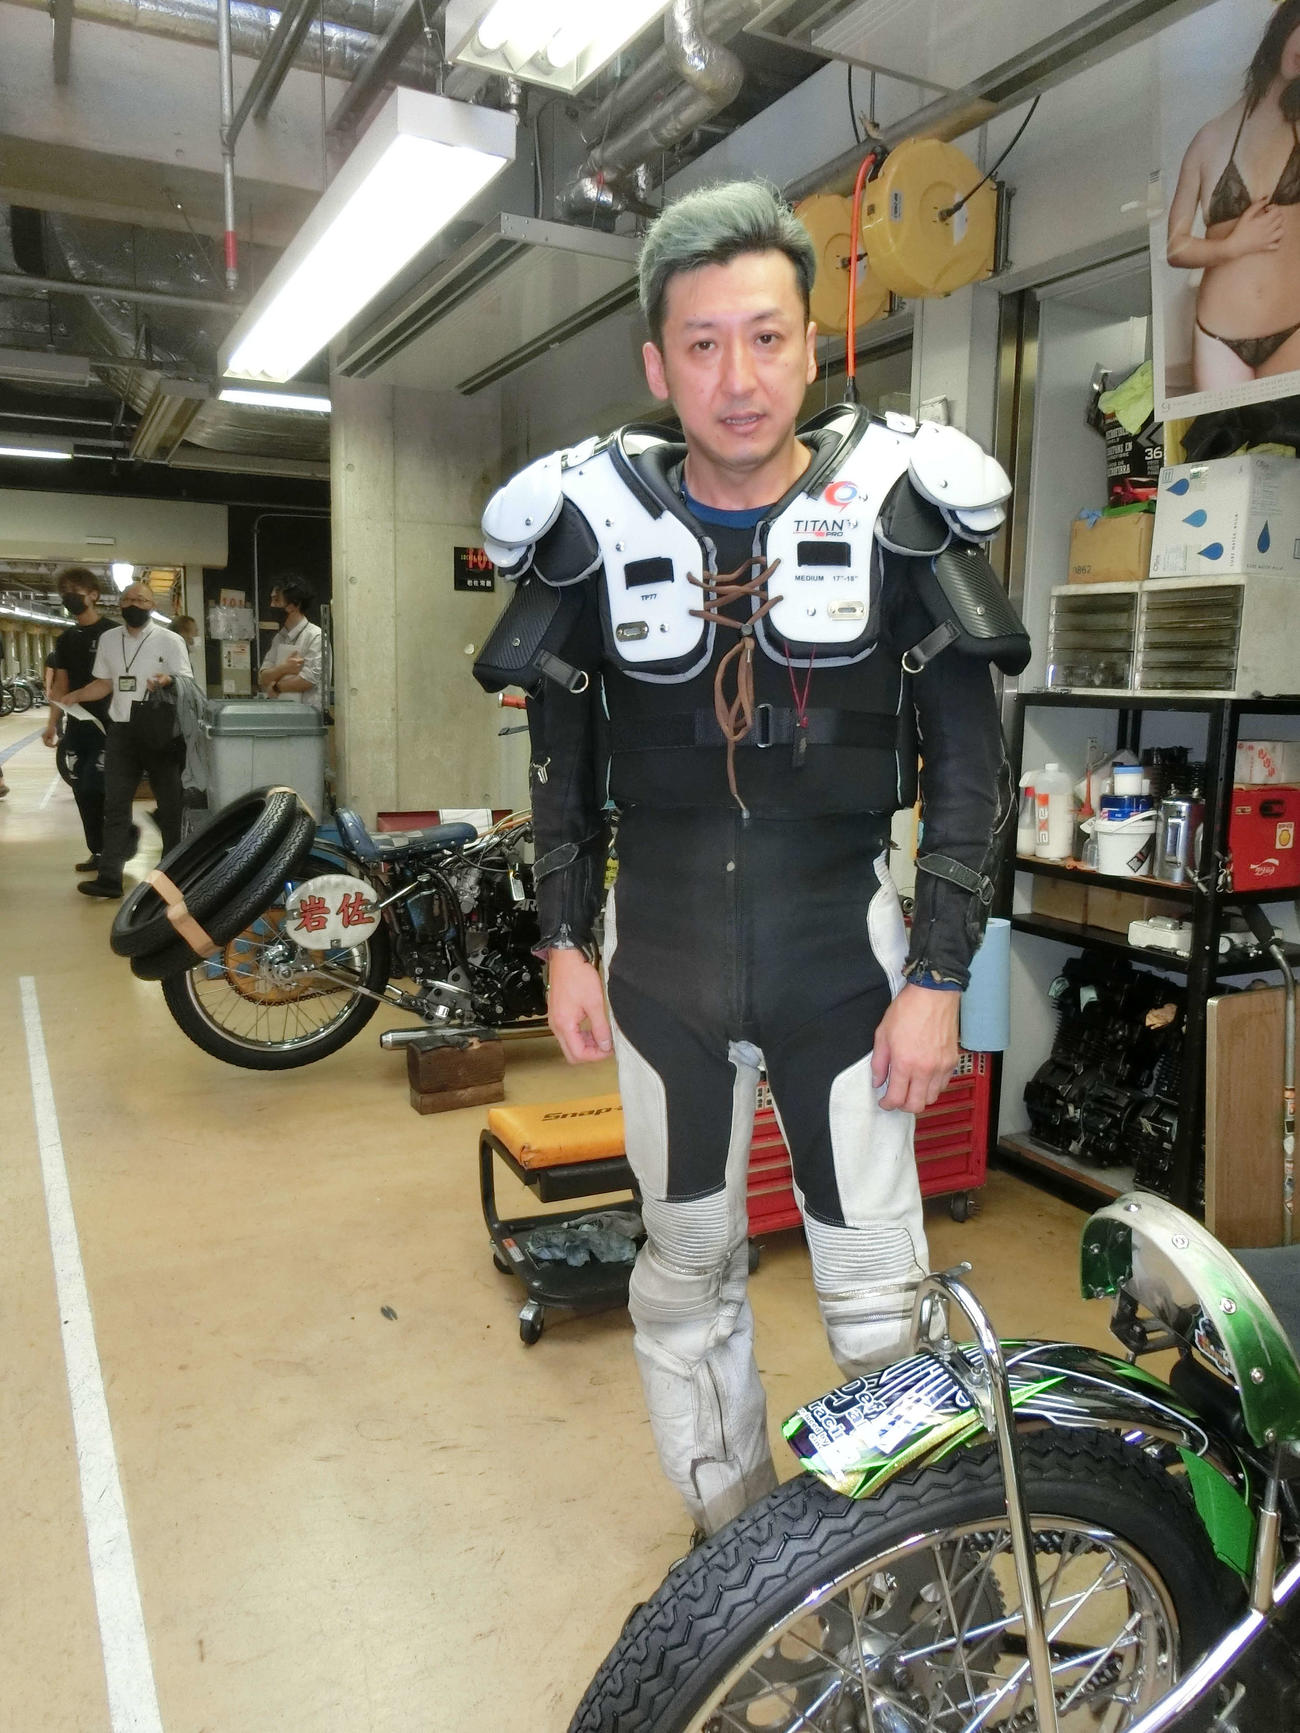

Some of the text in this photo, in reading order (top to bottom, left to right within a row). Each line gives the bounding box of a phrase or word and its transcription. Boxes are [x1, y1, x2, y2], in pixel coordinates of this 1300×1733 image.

[1144, 446, 1163, 460] 36
[794, 519, 847, 532] TITAN
[294, 892, 376, 933] 岩佐
[541, 1105, 623, 1122] Snap-
